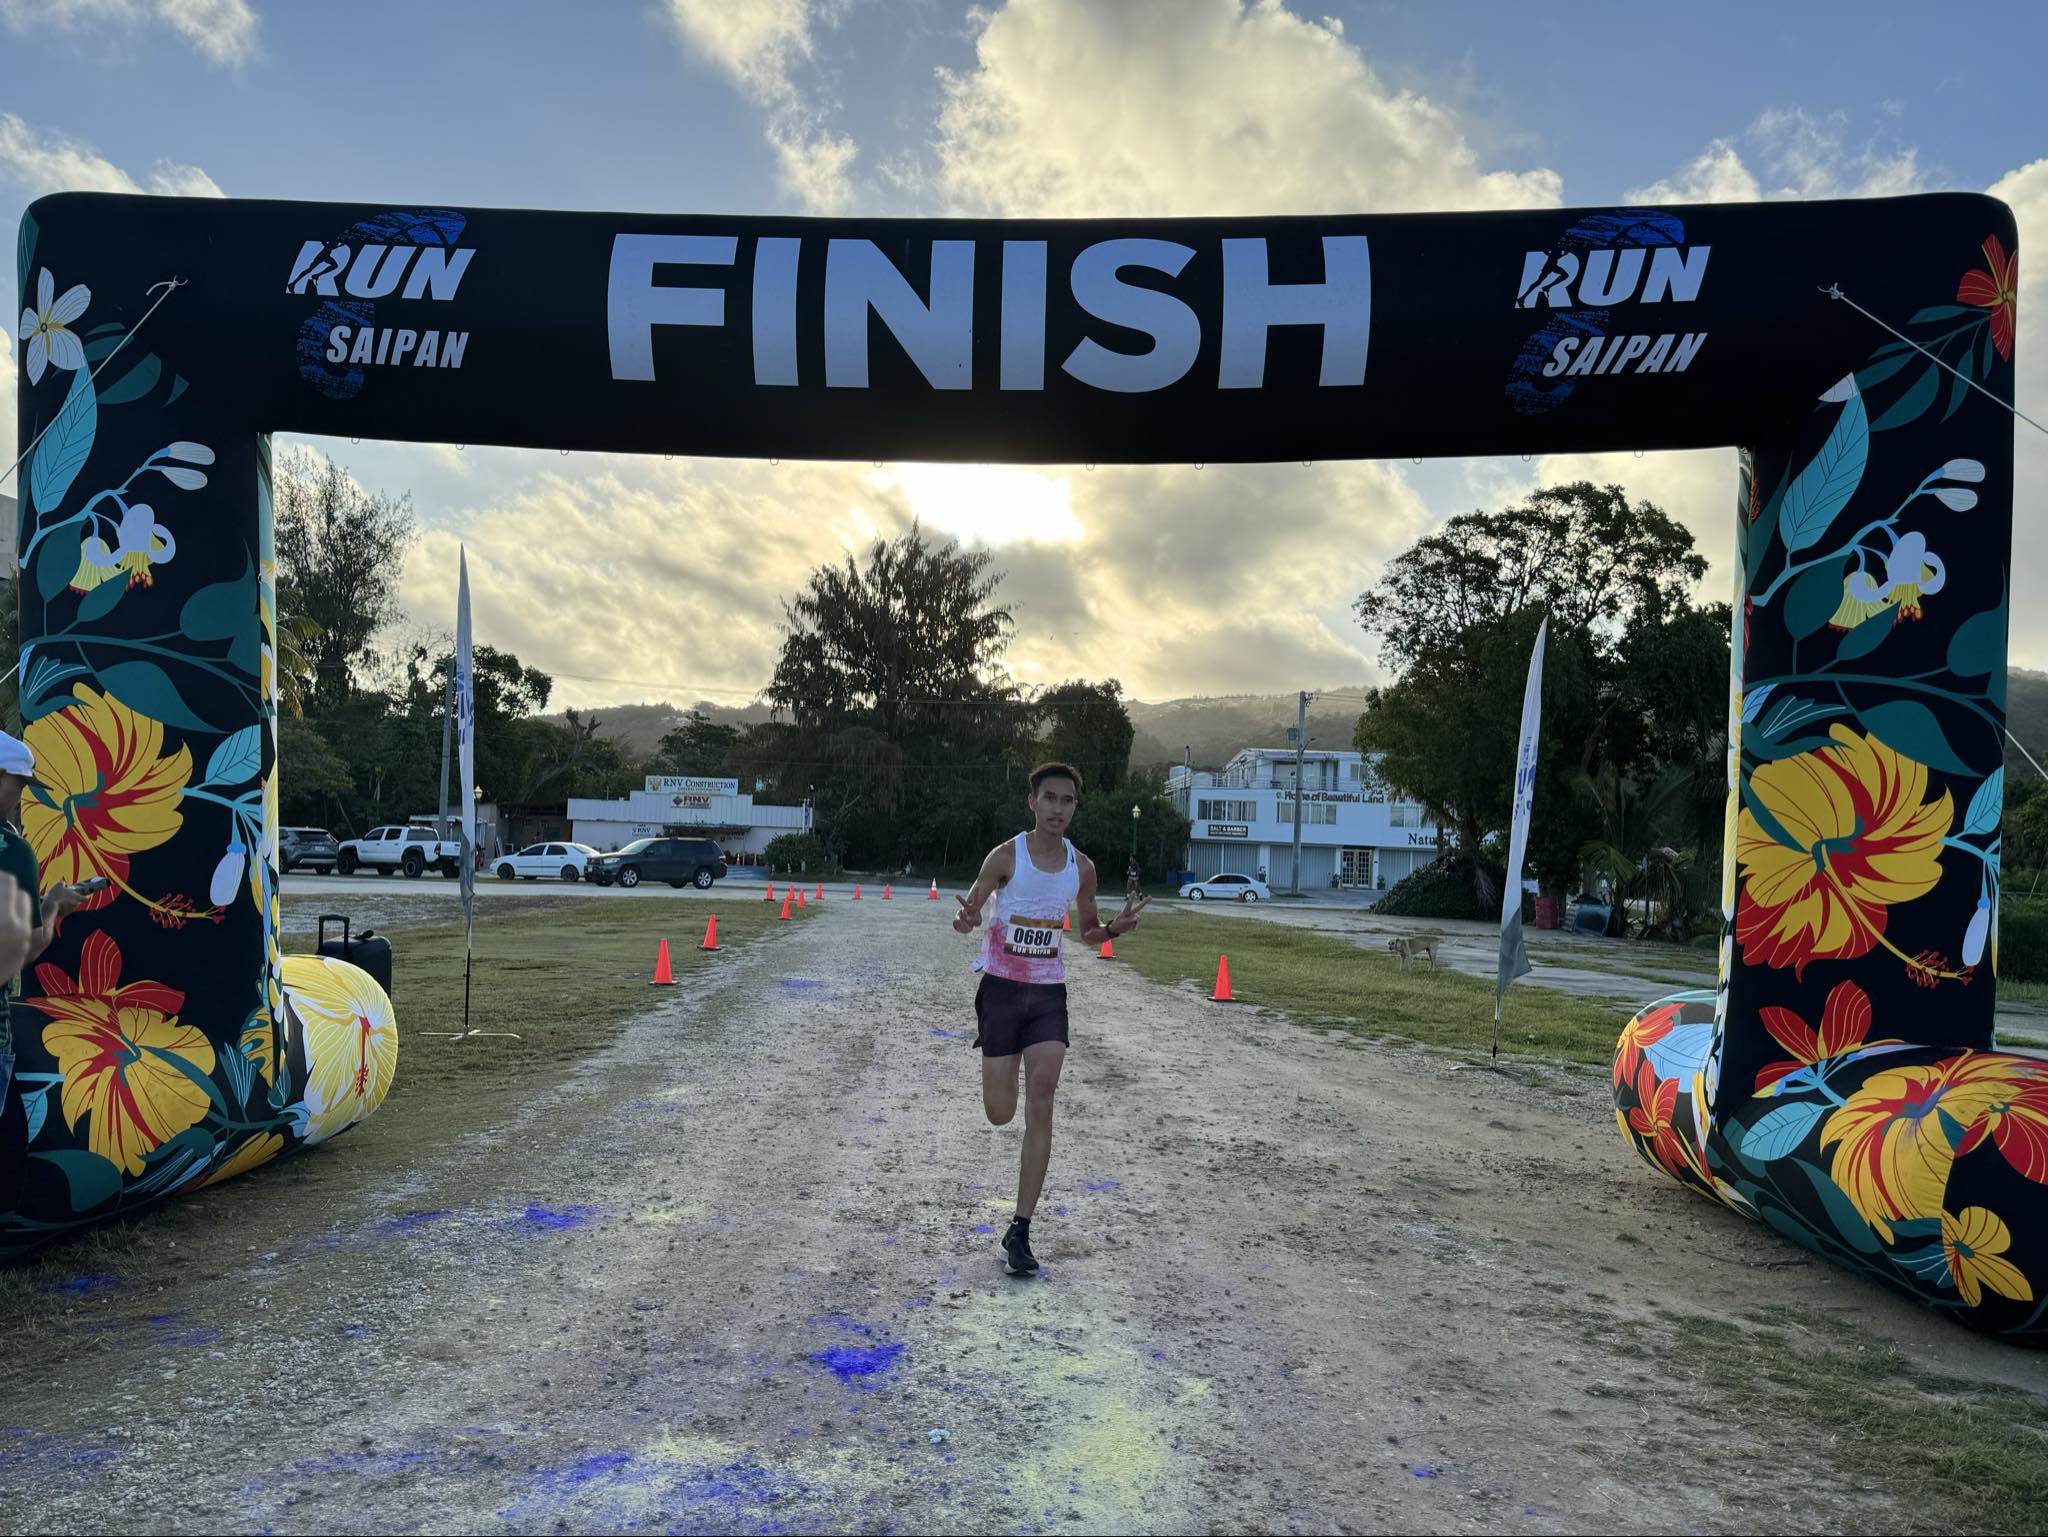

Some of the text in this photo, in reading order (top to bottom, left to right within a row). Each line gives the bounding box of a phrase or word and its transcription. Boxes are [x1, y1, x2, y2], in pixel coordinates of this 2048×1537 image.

[285, 240, 477, 301] RUN
[1514, 246, 1711, 309] RUN
[607, 233, 1371, 393] FINISH
[326, 325, 470, 369] SAIPAN
[1542, 332, 1708, 378] SAIPAN
[663, 778, 683, 787] RNV
[1013, 927, 1053, 946] 0680
